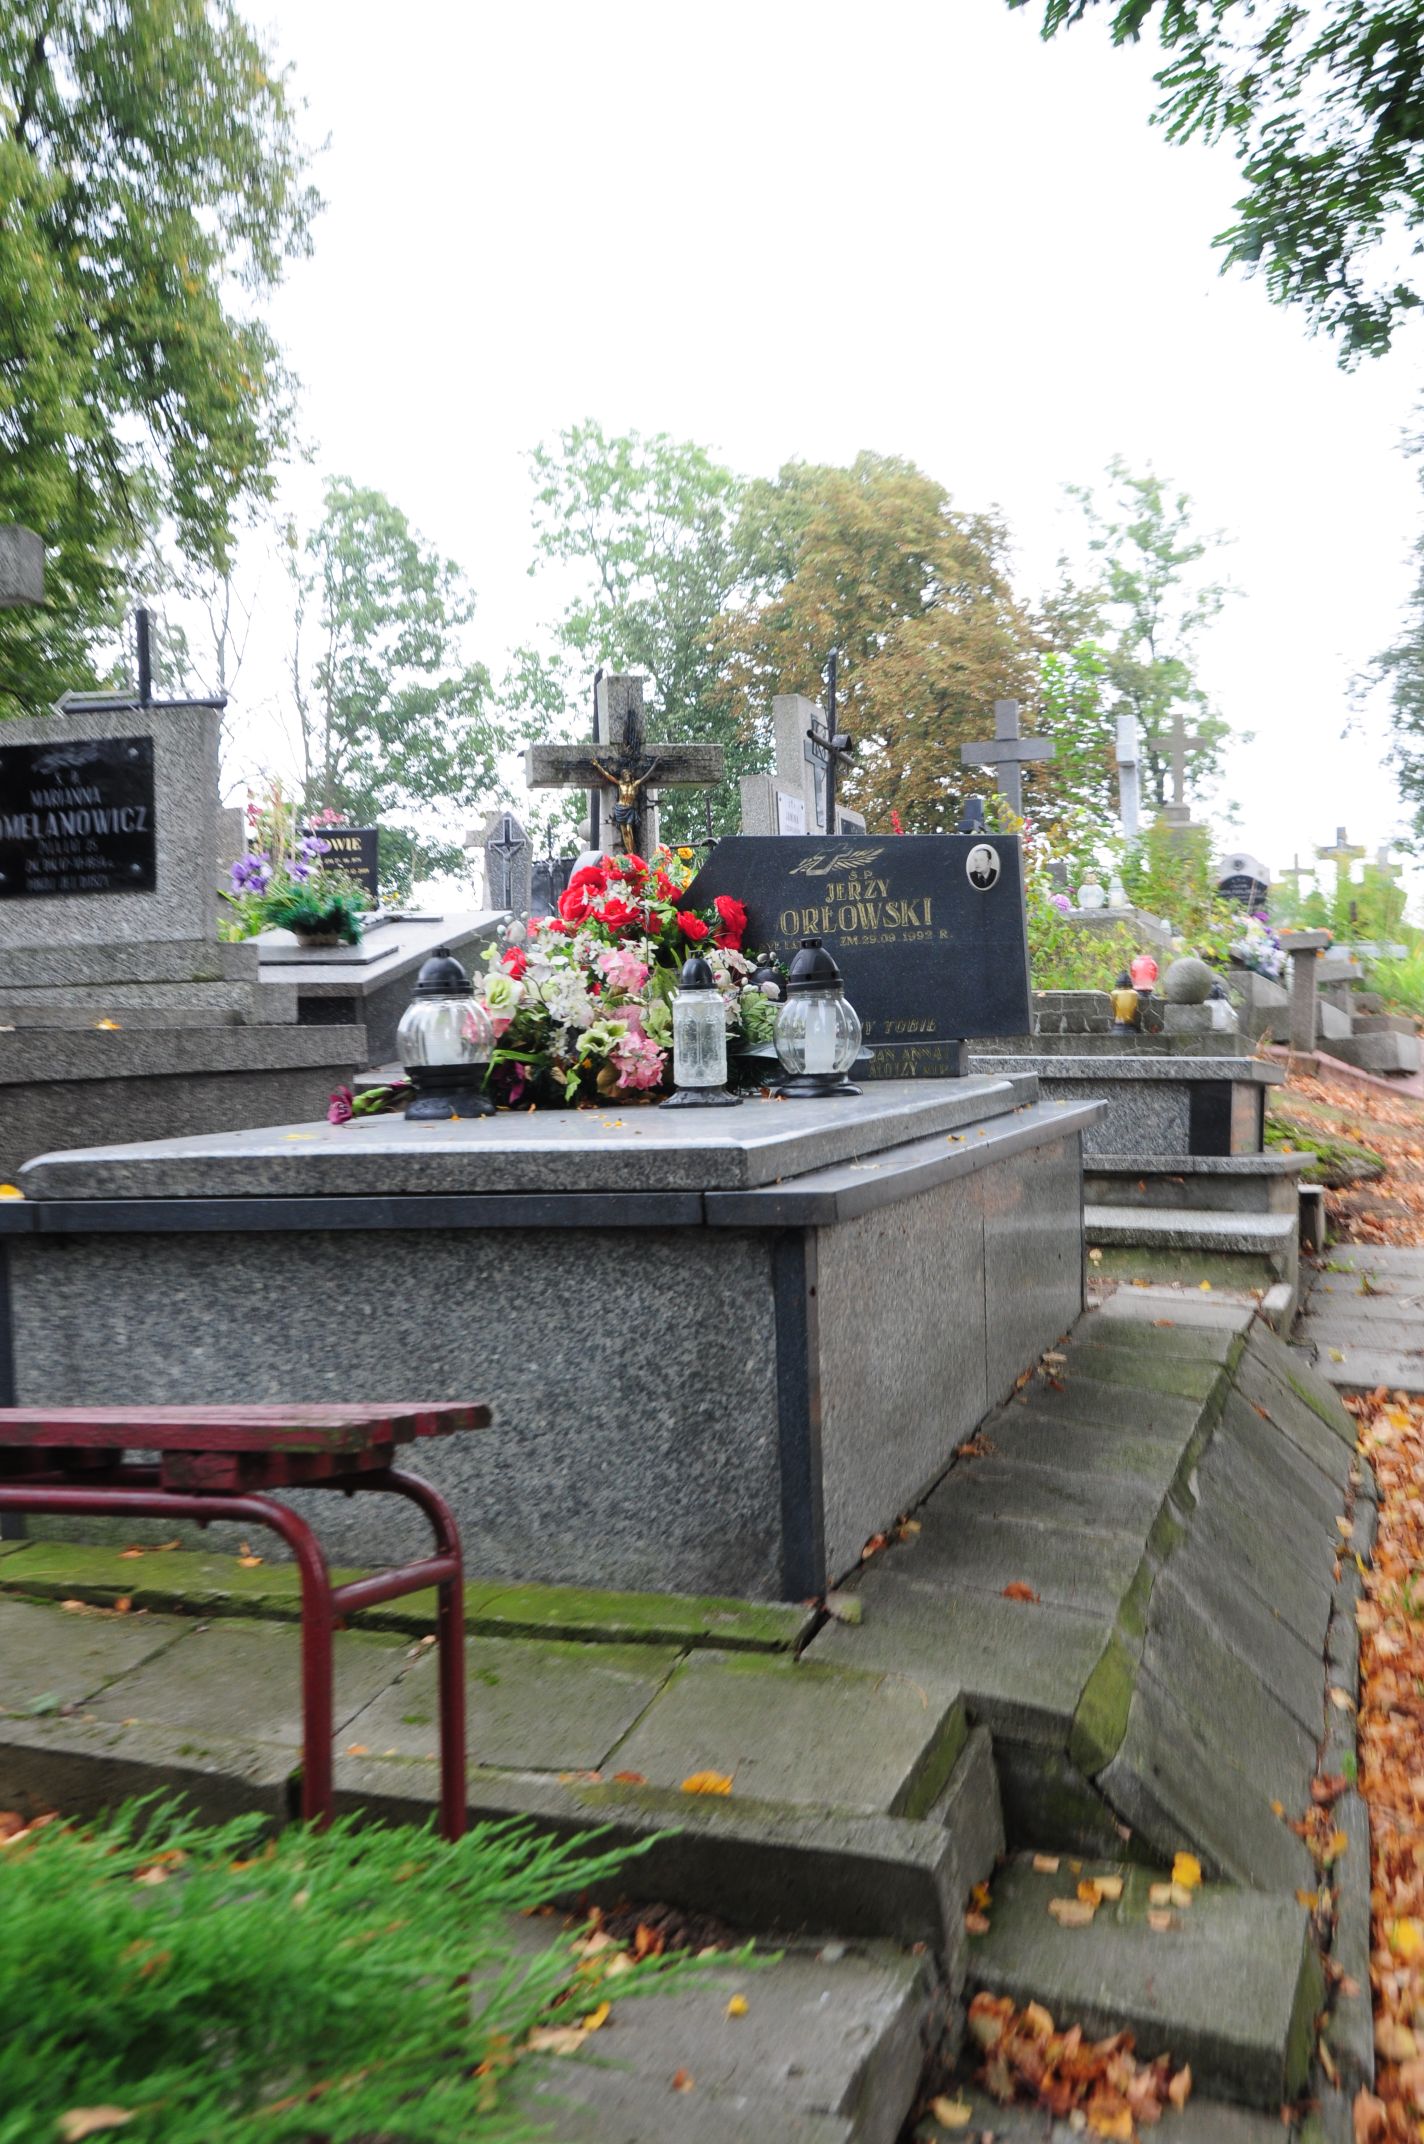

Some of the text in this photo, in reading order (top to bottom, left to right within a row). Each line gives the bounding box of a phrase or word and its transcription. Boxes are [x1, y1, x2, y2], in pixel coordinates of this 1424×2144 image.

[30, 786, 101, 807] MARIANNA
[0, 806, 147, 839] MELANOWICZ
[825, 879, 889, 903] JERZY
[780, 897, 932, 935] ORŁOWSKI
[902, 930, 933, 941] 1992
[884, 1018, 936, 1034] TOBIE
